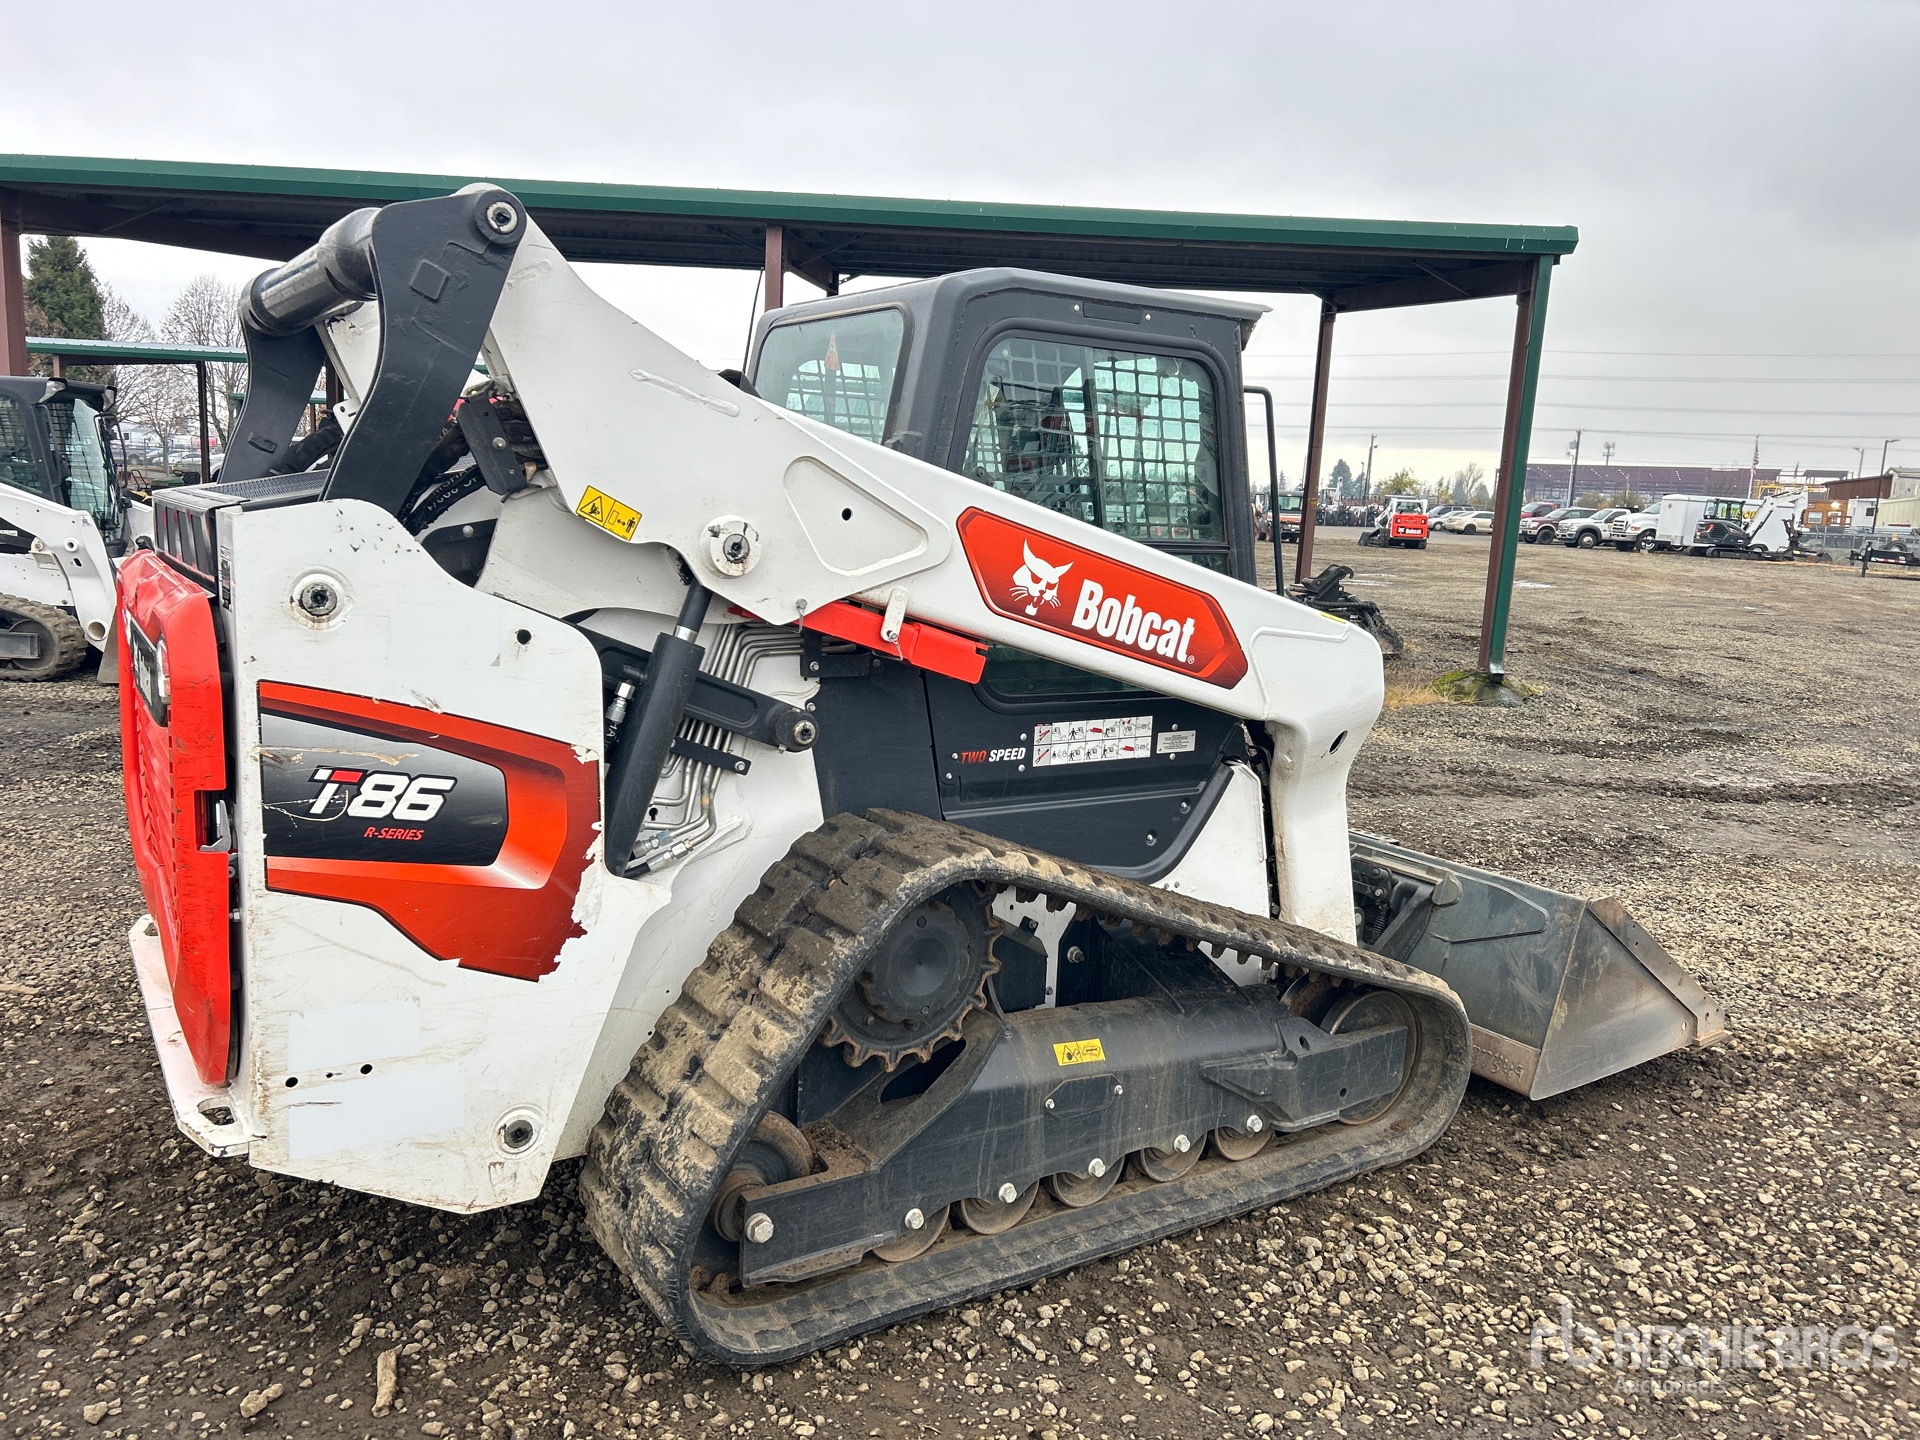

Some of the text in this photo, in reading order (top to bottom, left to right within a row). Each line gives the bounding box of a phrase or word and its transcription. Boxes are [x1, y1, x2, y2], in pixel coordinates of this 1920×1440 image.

[1072, 579, 1195, 663] Bobcat
[961, 748, 1026, 764] TWO SPEED
[309, 767, 456, 822] T86
[364, 826, 424, 841] R-SERIES
